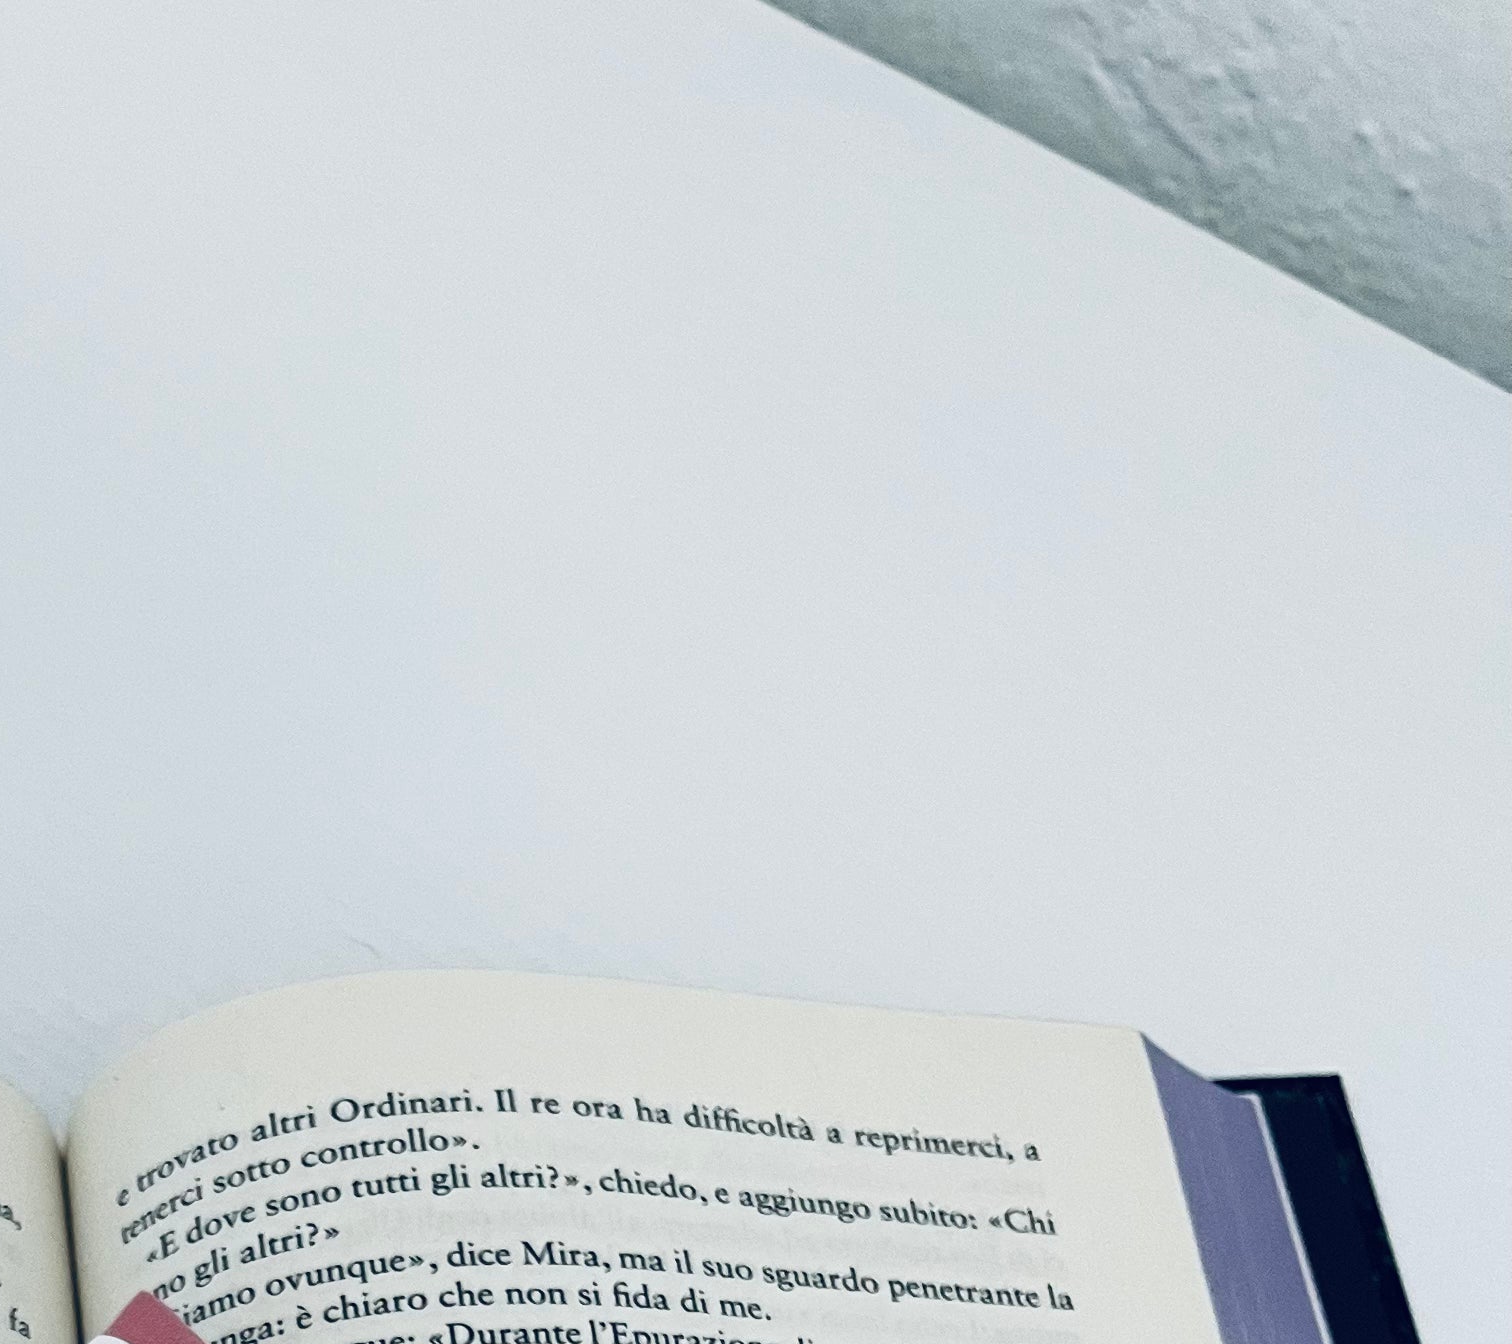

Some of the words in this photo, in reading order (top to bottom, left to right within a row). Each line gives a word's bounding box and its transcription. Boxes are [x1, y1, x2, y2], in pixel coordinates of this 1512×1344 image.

[116, 1188, 130, 1207] e
[136, 1133, 239, 1193] trovato
[250, 1104, 318, 1142] altri
[329, 1088, 484, 1123] Ordinari.
[493, 1087, 518, 1113] Il
[529, 1097, 561, 1115] re
[572, 1100, 625, 1120] ora
[632, 1096, 673, 1125] ha
[683, 1103, 816, 1142] difficoltà
[826, 1127, 845, 1145] a
[854, 1128, 1015, 1165] reprimerci,
[1024, 1143, 1042, 1162] a
[185, 1214, 257, 1245] dove
[265, 1185, 342, 1217] sono
[351, 1166, 422, 1199] tutti
[430, 1163, 472, 1197] gli
[598, 1167, 710, 1207] chiedo,
[713, 1185, 731, 1205] e
[738, 1187, 873, 1224] aggiungo
[879, 1197, 980, 1231] subito:
